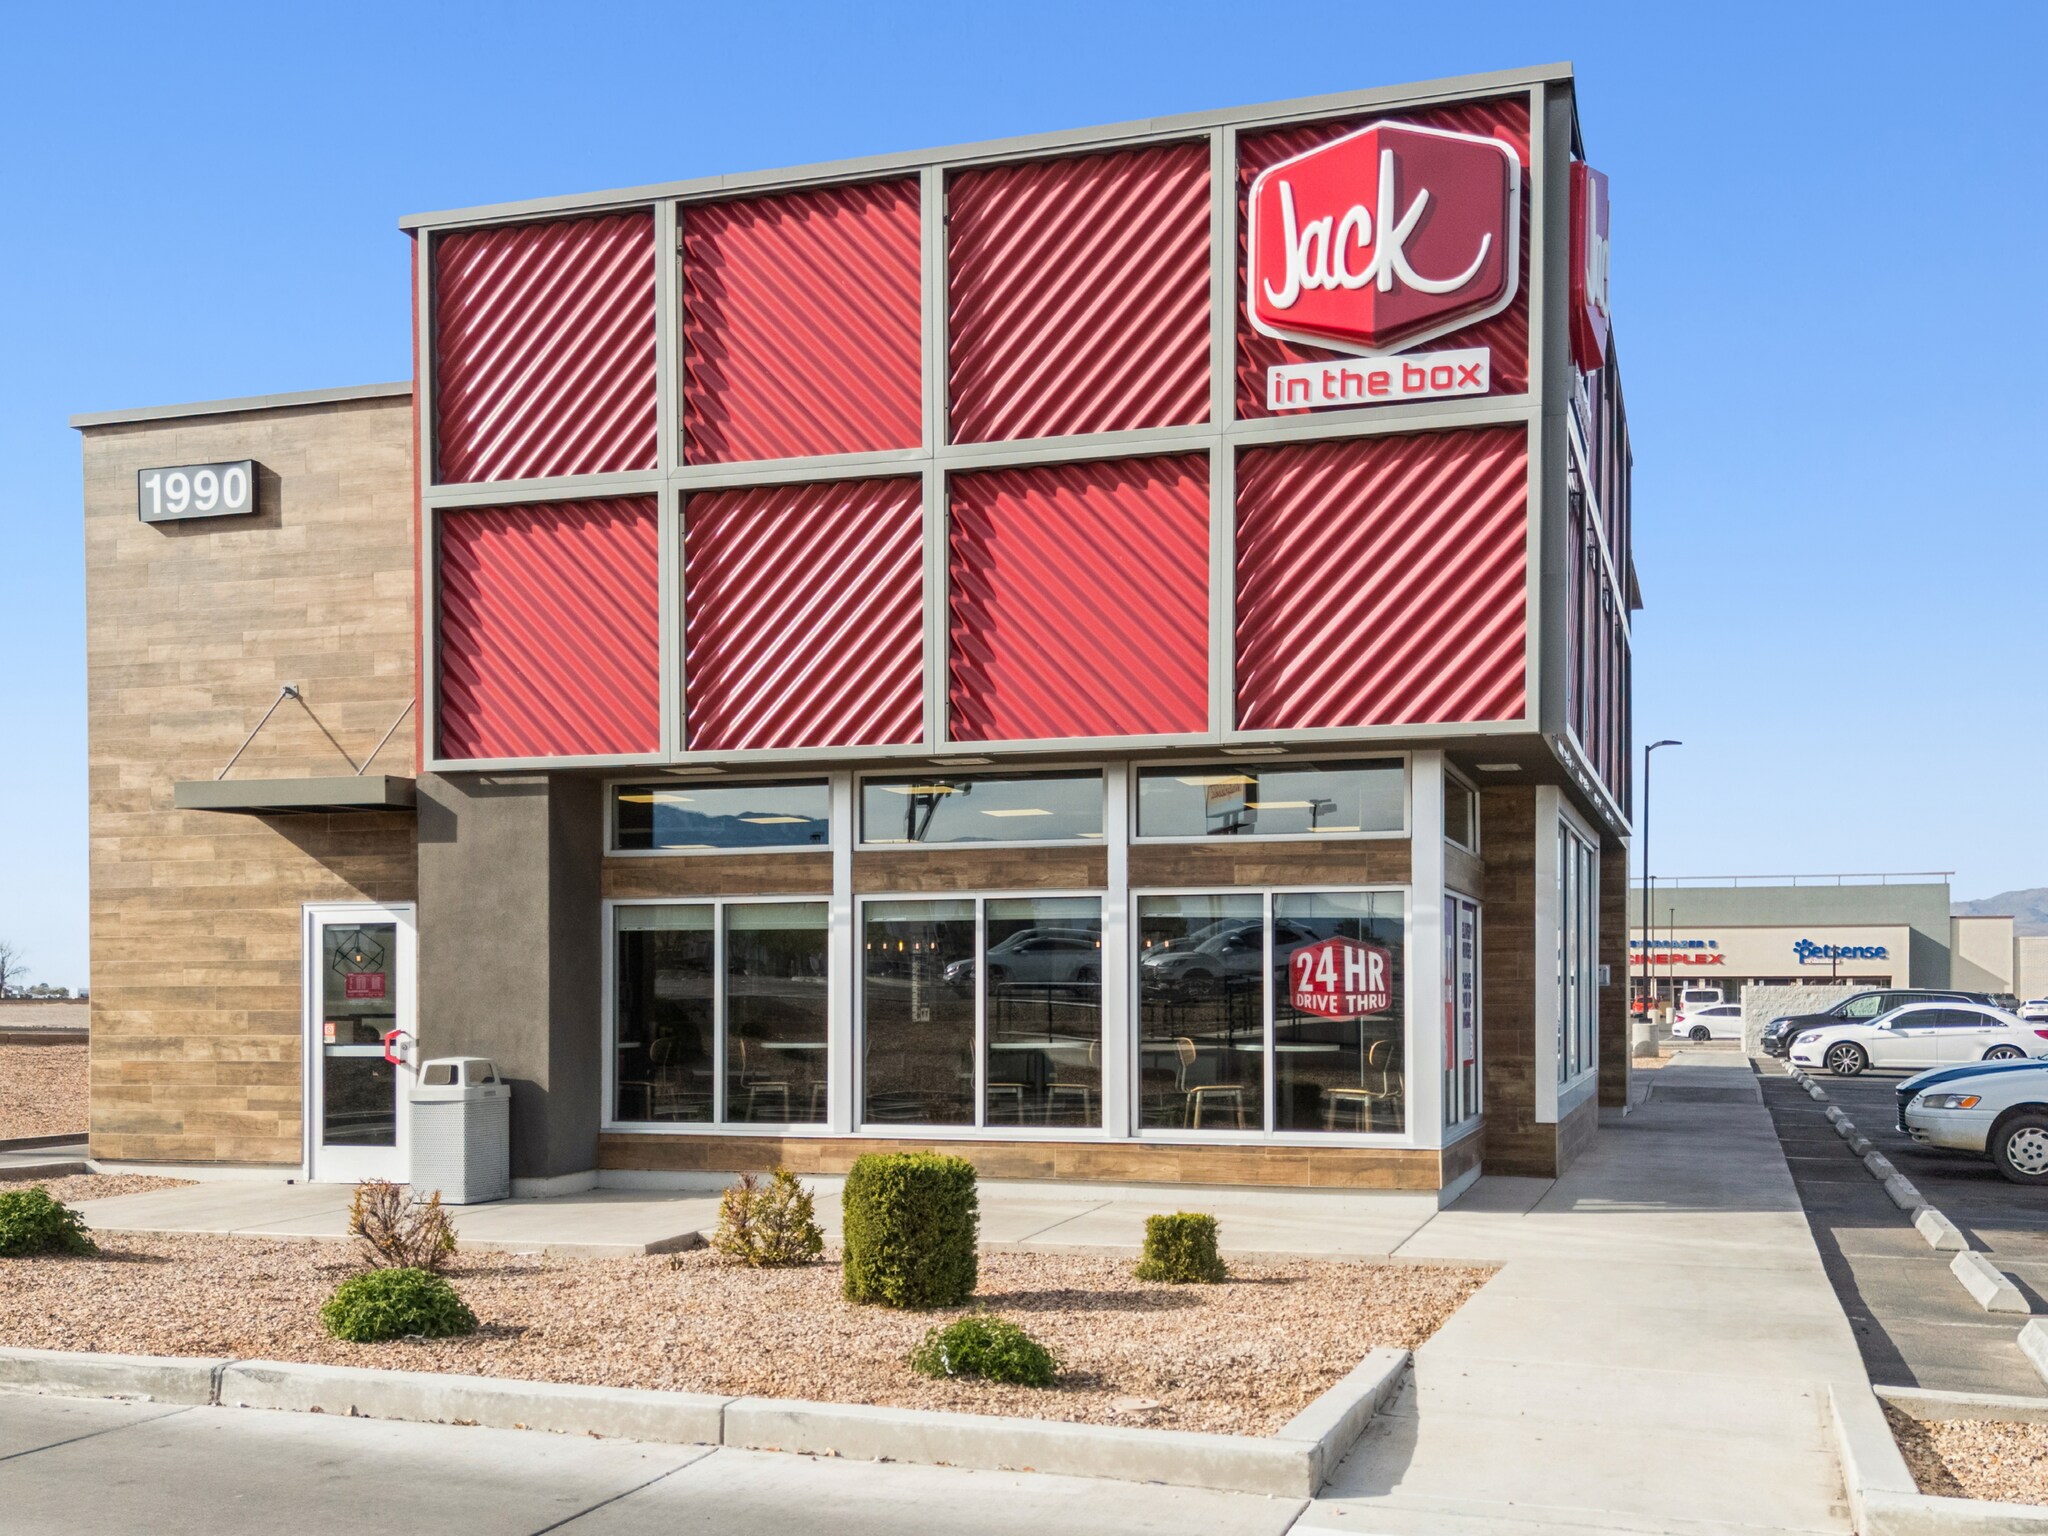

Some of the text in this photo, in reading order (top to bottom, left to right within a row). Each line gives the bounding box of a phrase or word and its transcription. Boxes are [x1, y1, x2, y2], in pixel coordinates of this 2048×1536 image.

[1263, 149, 1492, 309] Jack
[1275, 362, 1481, 404] in the box
[145, 467, 247, 514] 1990
[1296, 945, 1385, 992] 24 HR
[1795, 942, 1887, 964] petsense
[1296, 993, 1386, 1013] DRIVE THRU
